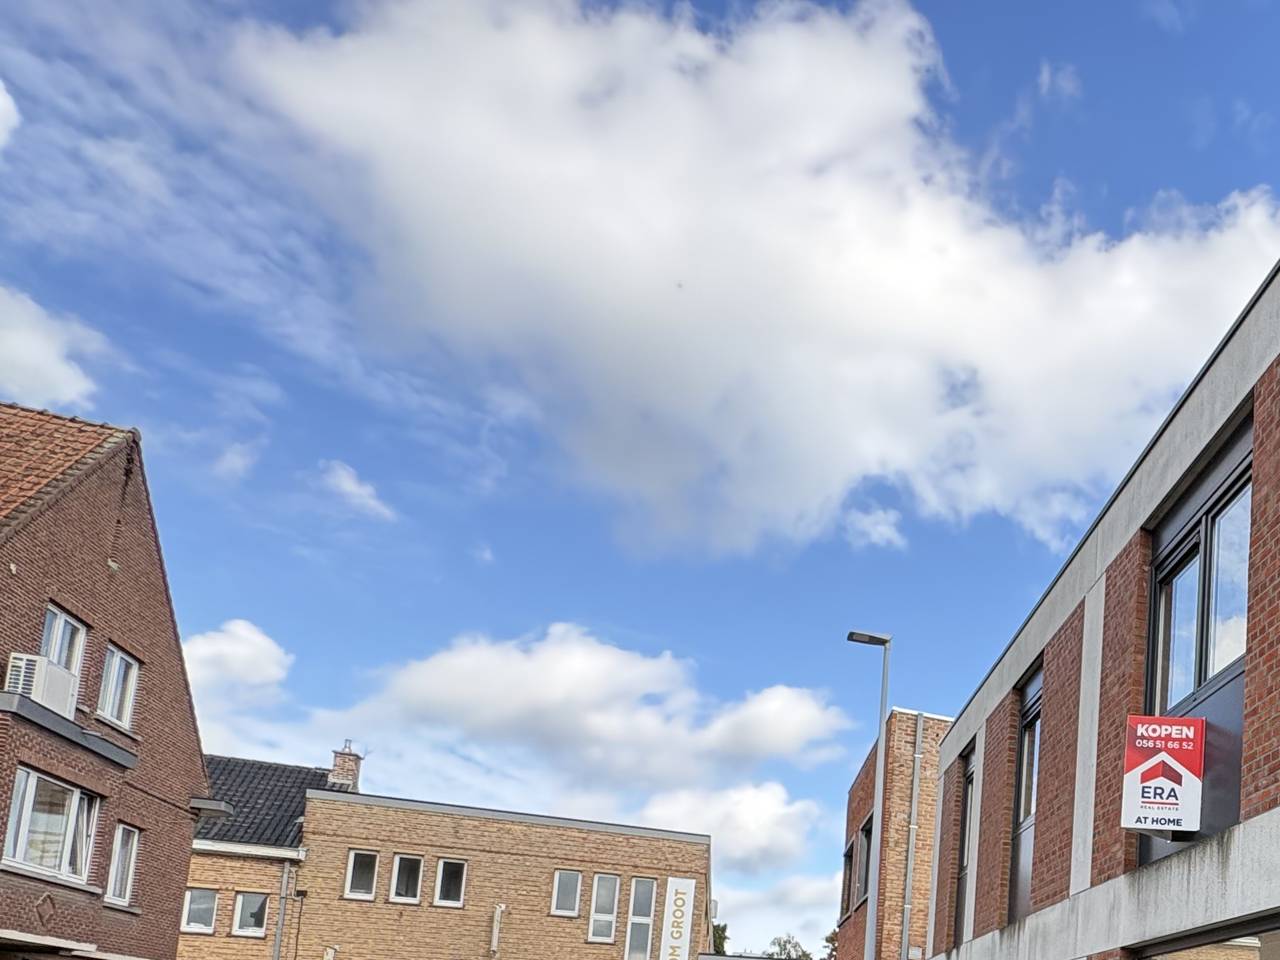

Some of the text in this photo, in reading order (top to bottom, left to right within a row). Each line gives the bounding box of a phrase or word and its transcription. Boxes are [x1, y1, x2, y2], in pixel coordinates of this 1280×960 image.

[1137, 724, 1194, 738] KOPEN
[1135, 739, 1194, 750] 056 51 66 52
[1141, 785, 1179, 800] ERA
[1135, 816, 1183, 826] AT HOME
[670, 889, 687, 939] GROOT
